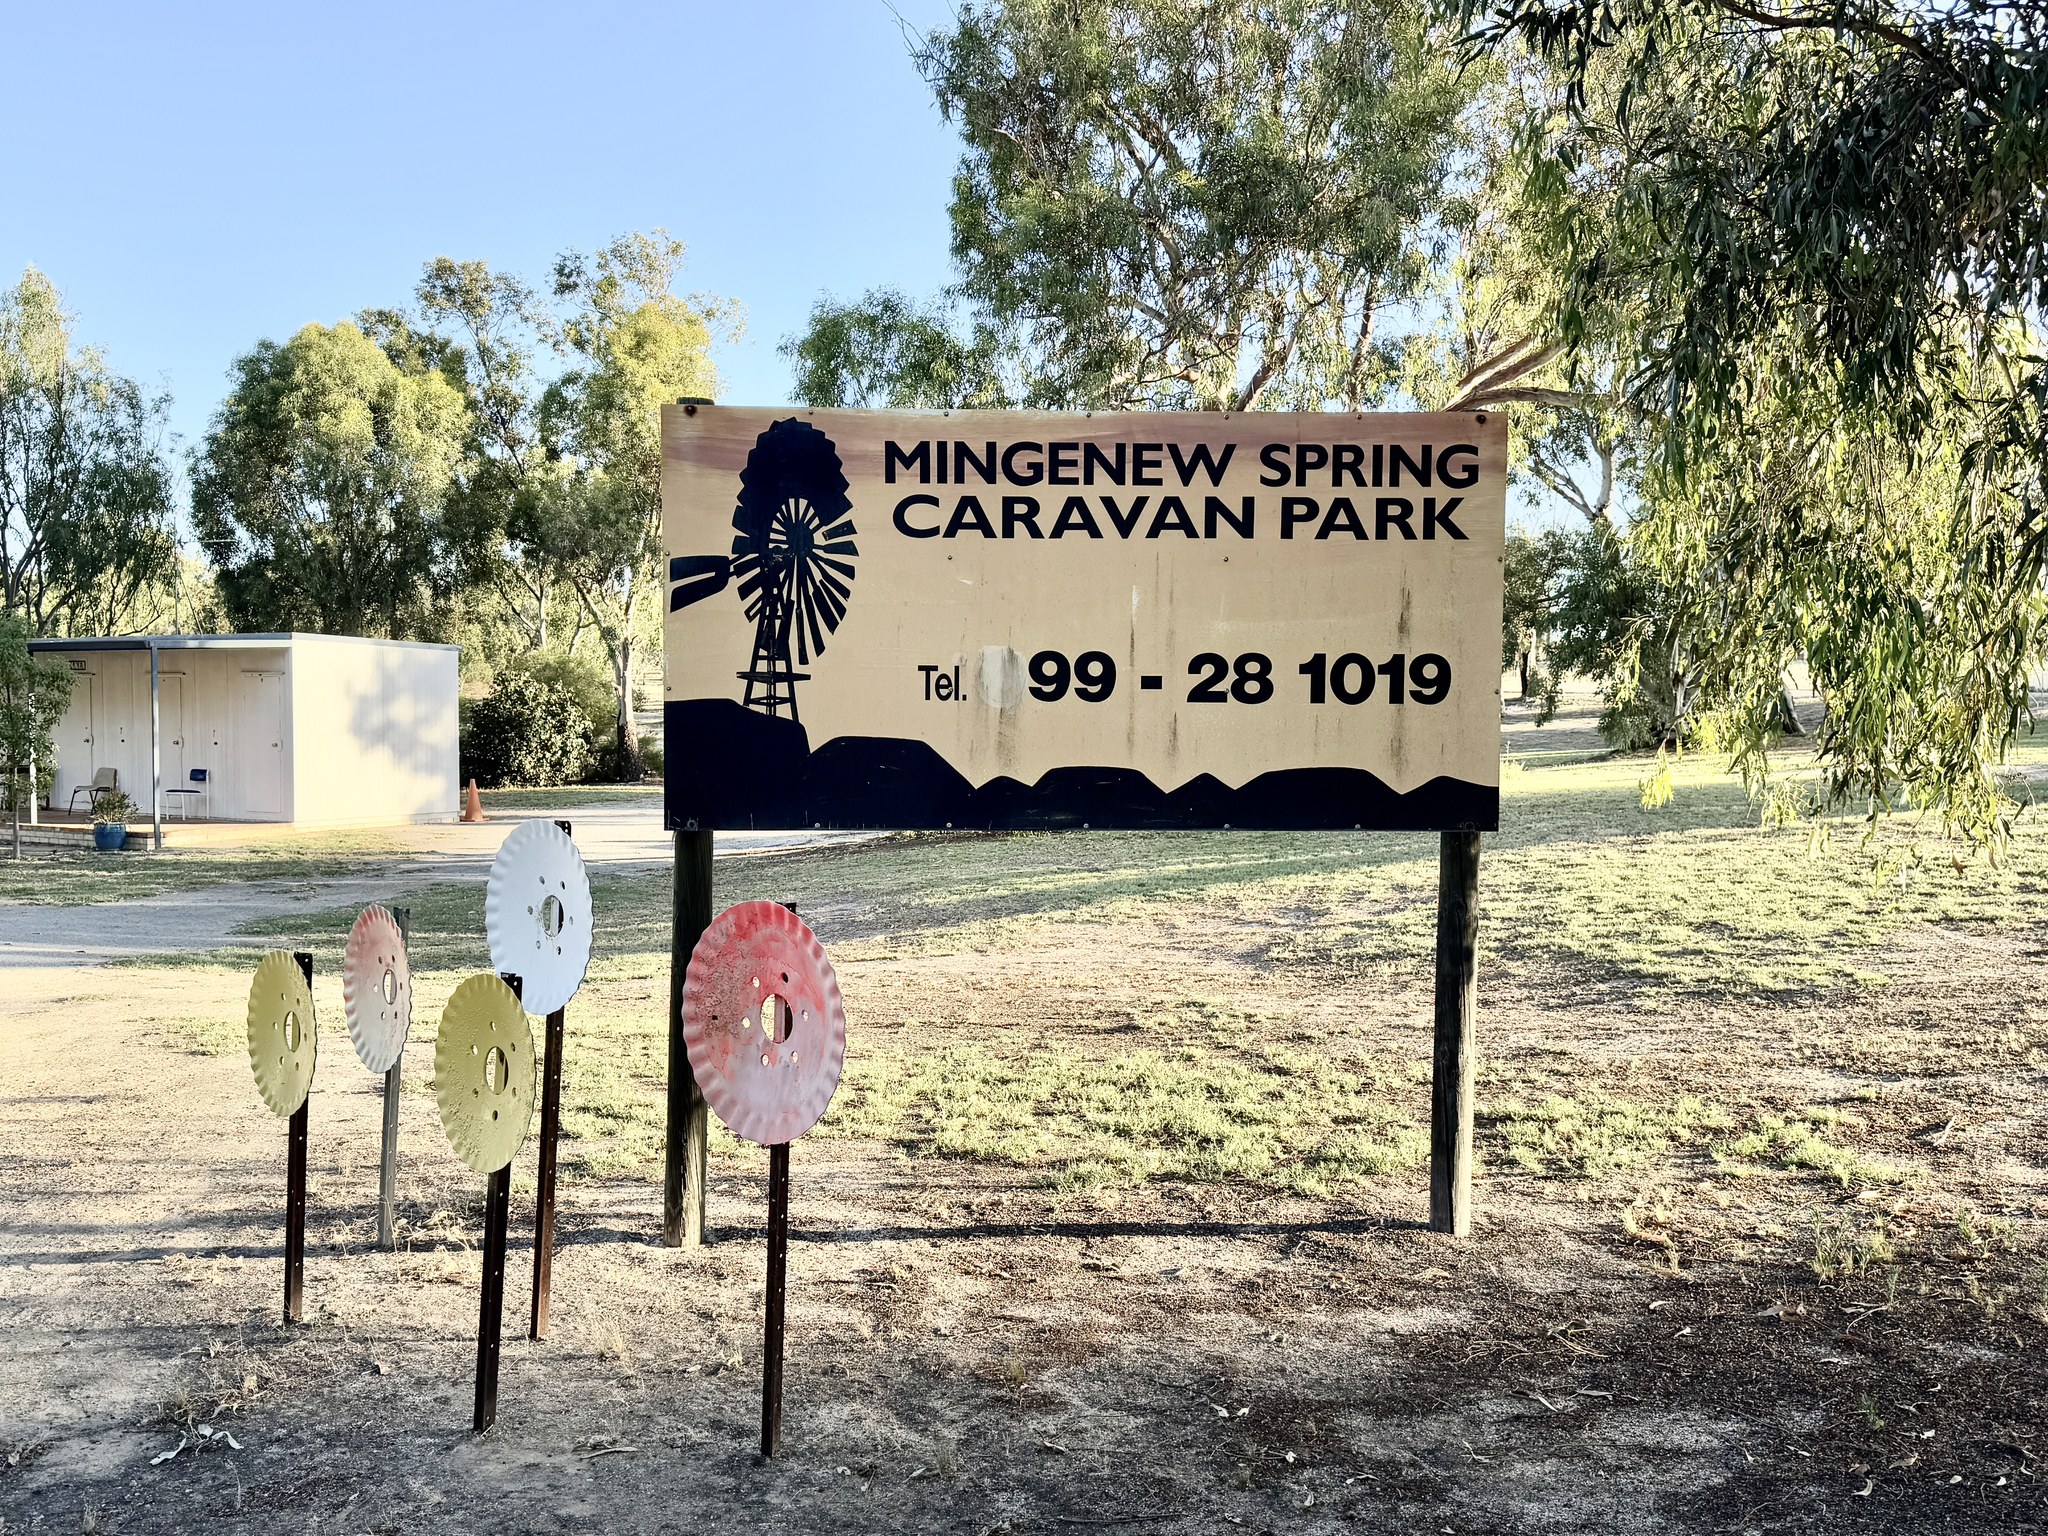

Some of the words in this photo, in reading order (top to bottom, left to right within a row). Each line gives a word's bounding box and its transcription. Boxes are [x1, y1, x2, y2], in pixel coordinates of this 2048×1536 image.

[884, 440, 1238, 488] MINGENEW
[1259, 443, 1480, 490] SPRING
[892, 494, 1255, 540] CARAVAN
[1280, 496, 1470, 541] PARK
[917, 665, 968, 702] Tel.
[1028, 650, 1117, 703] 99
[1186, 652, 1274, 705] 28
[1298, 652, 1452, 706] 1019
